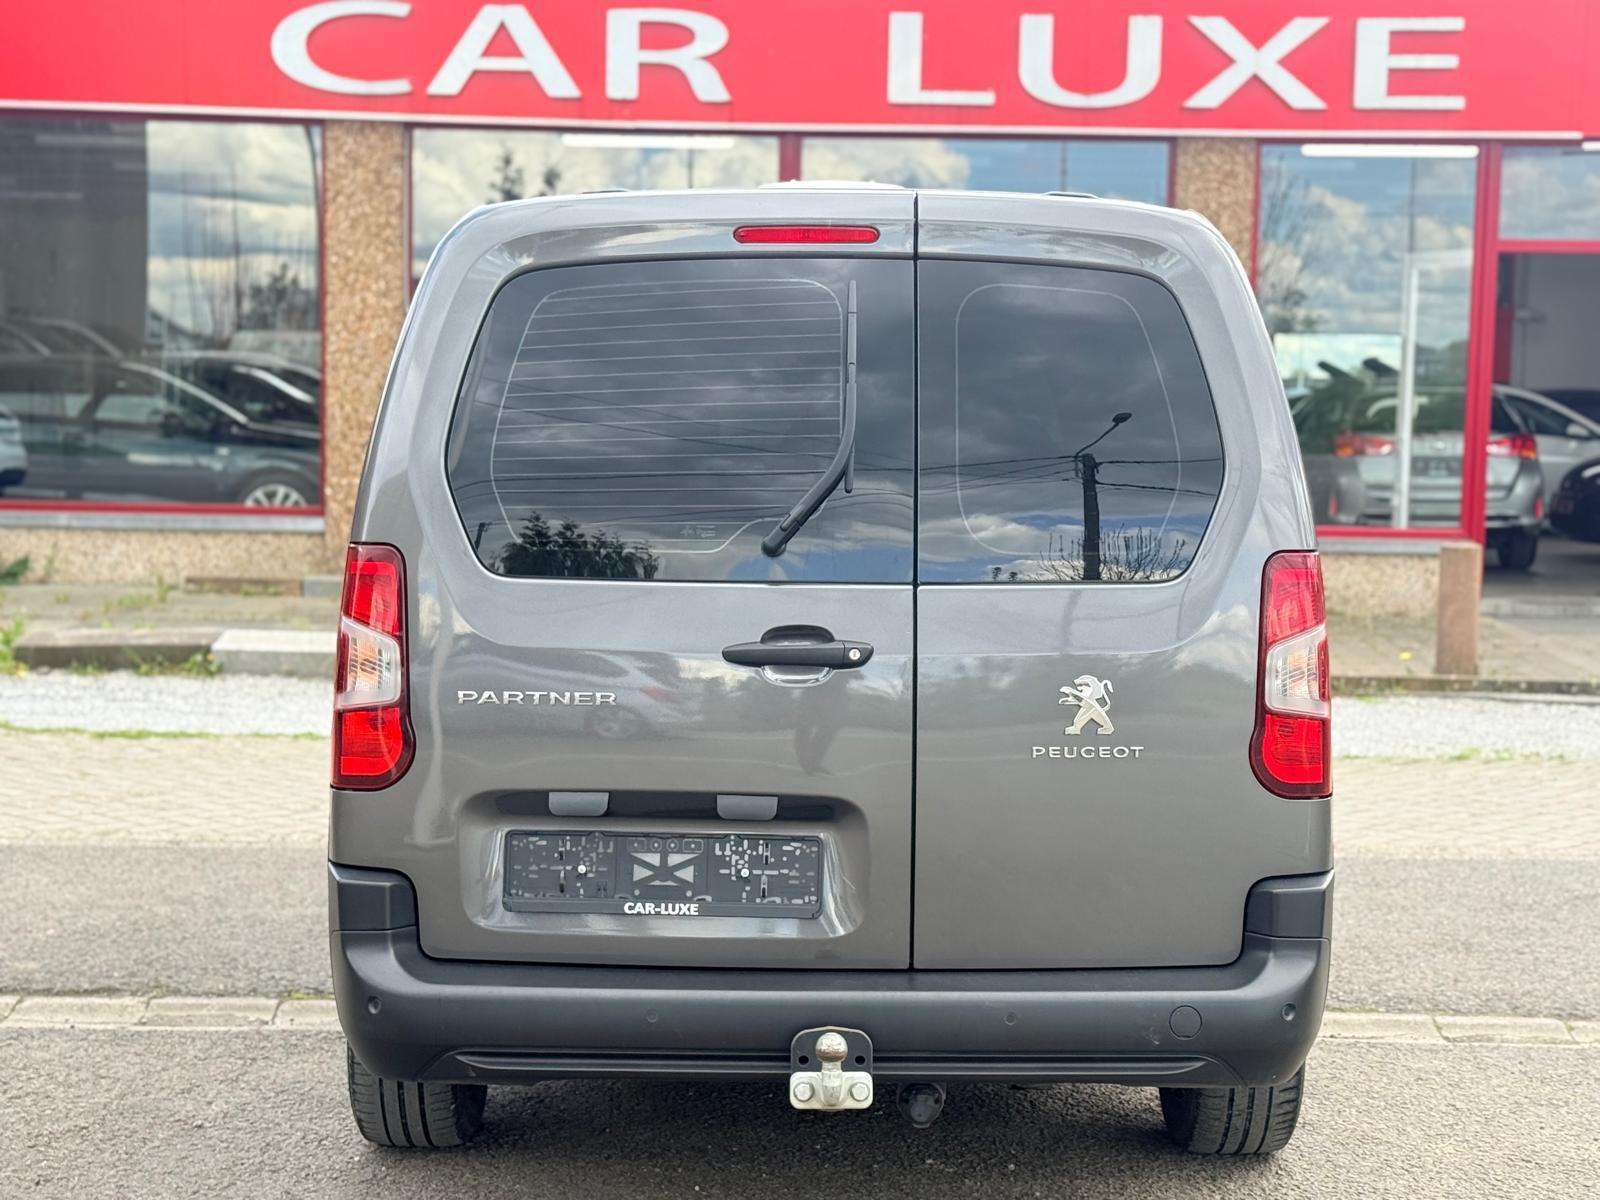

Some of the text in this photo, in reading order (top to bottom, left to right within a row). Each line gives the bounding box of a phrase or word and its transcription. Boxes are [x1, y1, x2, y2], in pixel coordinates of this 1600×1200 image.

[270, 0, 1466, 111] CAR LUXE
[456, 690, 617, 706] PARTNER
[1031, 746, 1144, 759] PEUGEOT
[623, 902, 699, 916] CAR-LUXE
